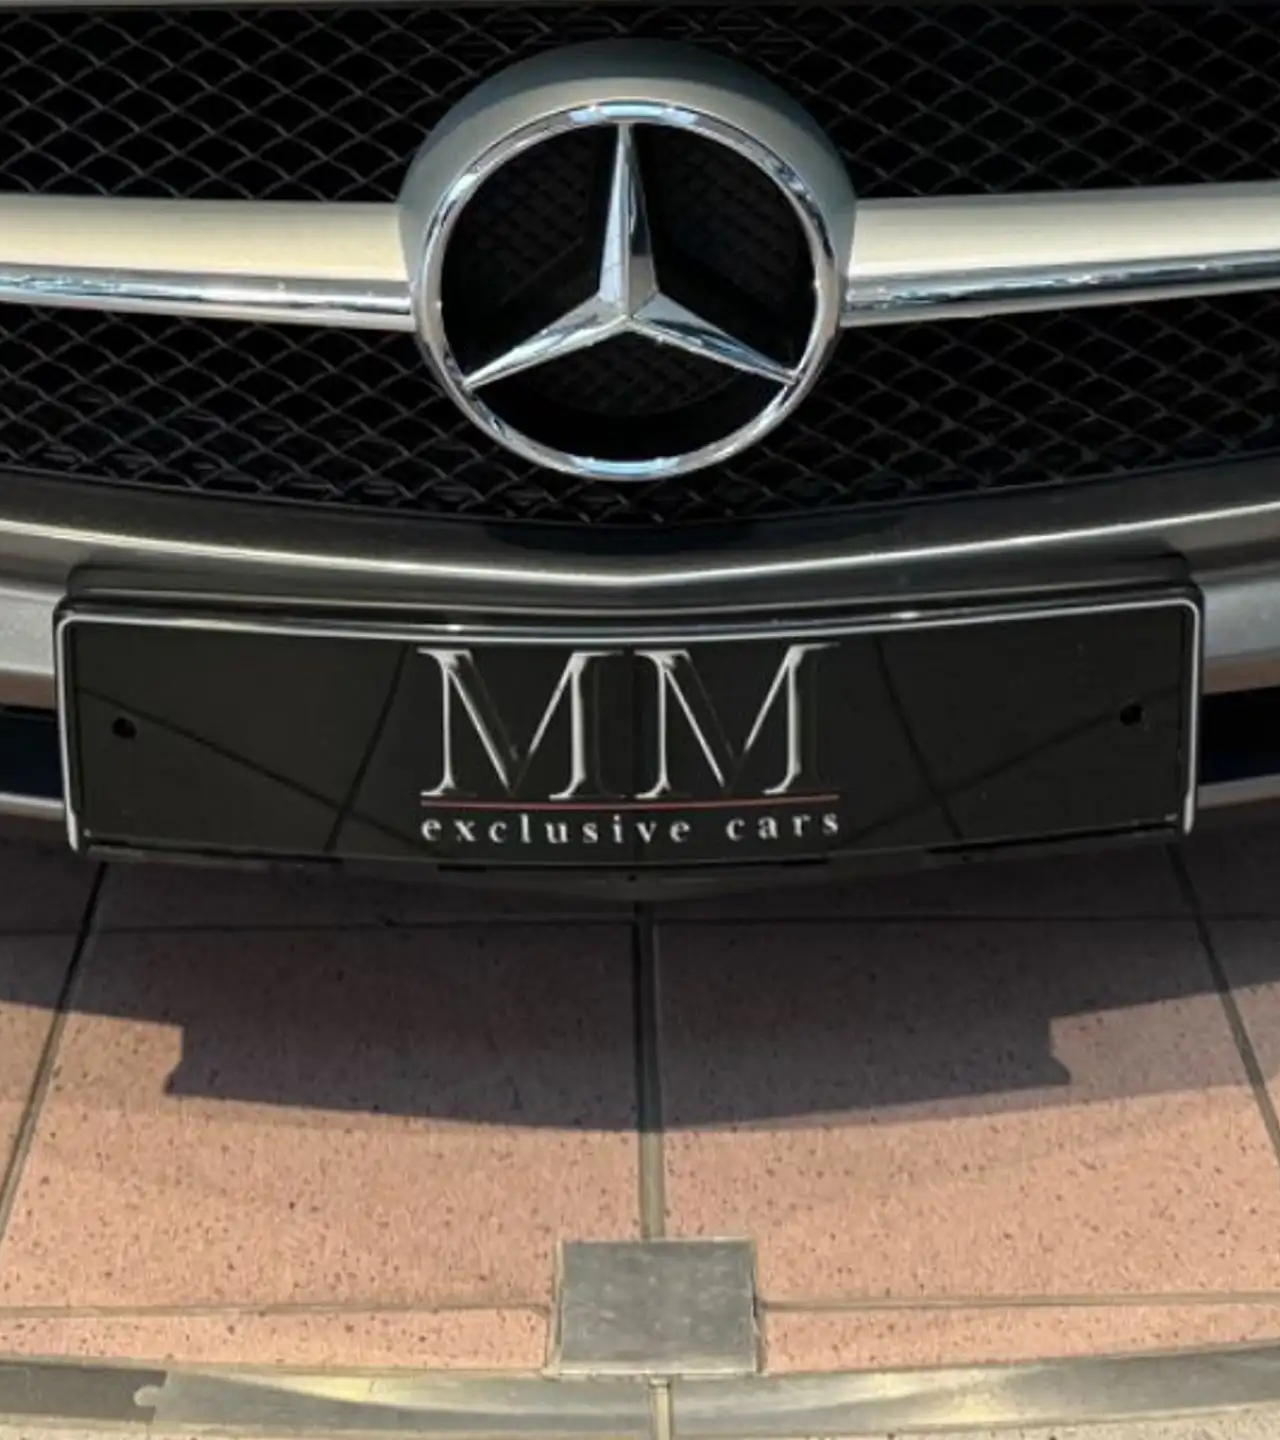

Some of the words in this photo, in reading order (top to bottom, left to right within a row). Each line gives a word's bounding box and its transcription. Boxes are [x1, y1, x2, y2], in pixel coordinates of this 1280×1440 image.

[417, 642, 841, 801] MM
[420, 812, 693, 845] exclusive
[724, 810, 841, 843] cars
